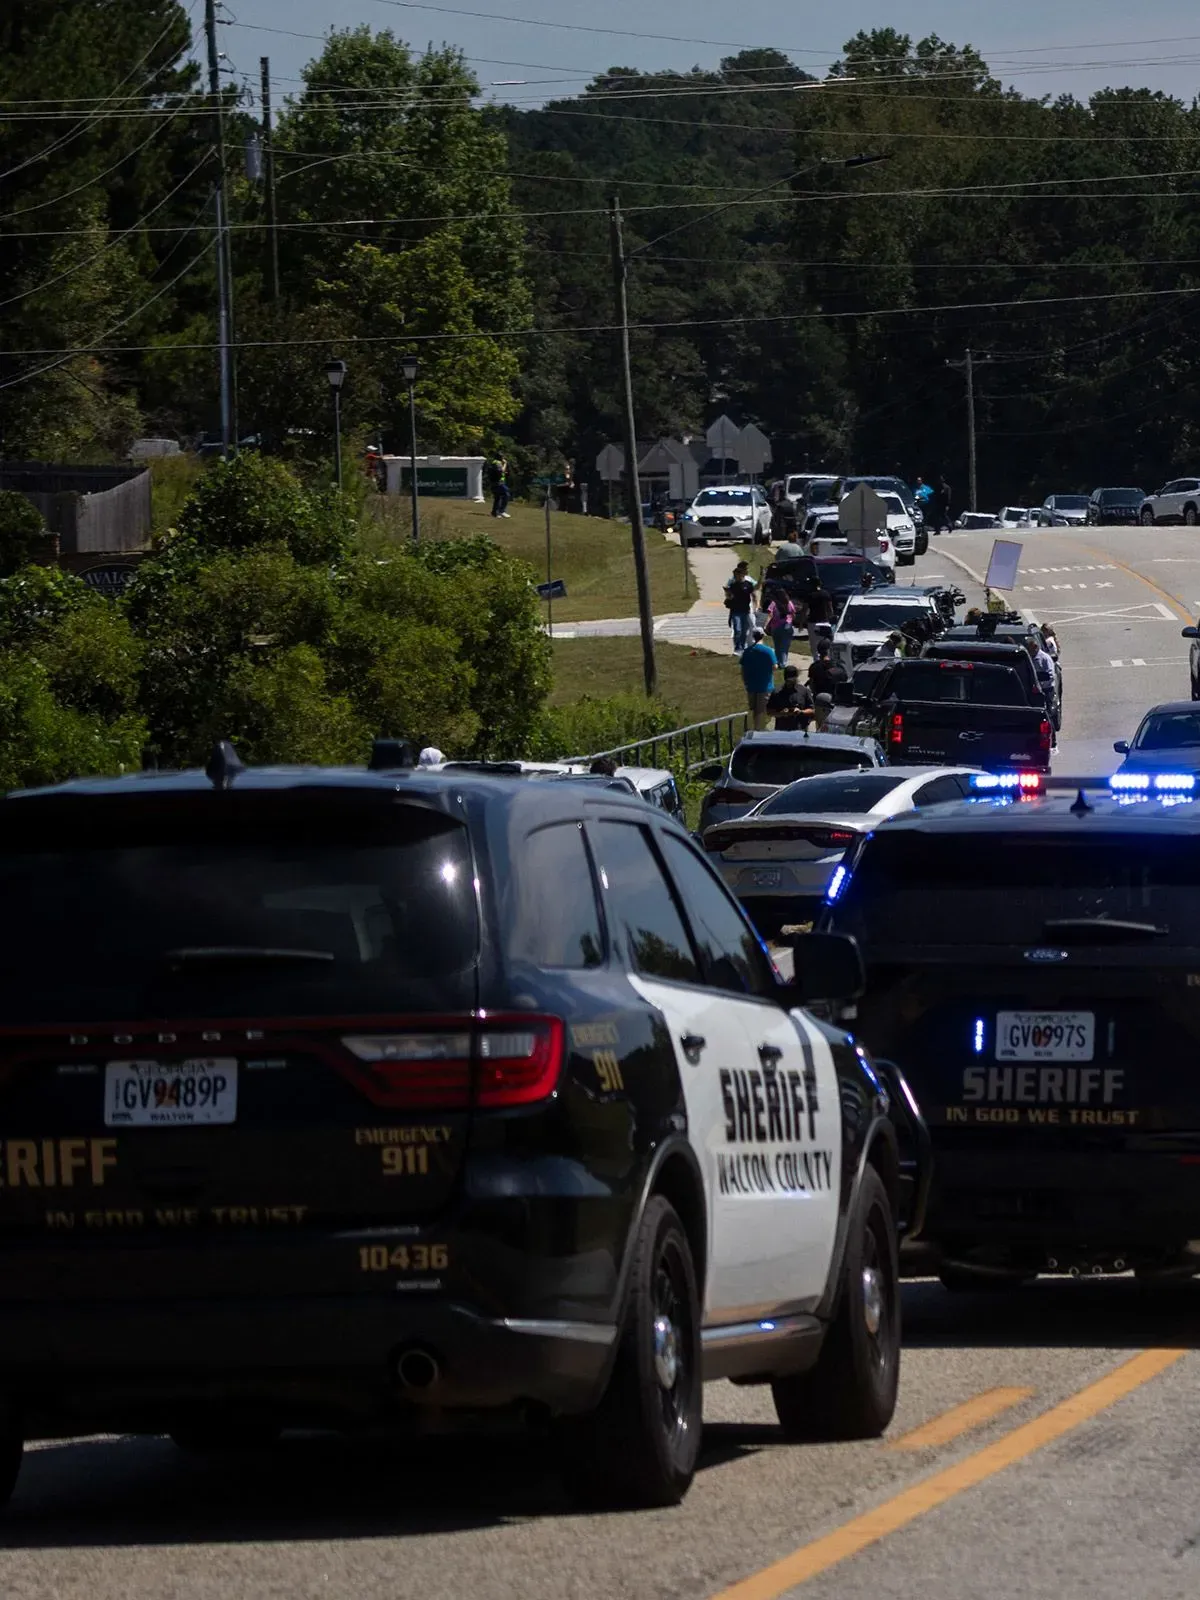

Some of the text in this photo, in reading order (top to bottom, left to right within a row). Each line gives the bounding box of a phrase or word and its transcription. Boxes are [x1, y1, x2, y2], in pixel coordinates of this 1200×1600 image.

[1010, 1025, 1086, 1048] GV0997S
[591, 1049, 625, 1092] 911
[962, 1066, 1125, 1104] SHERIFF
[123, 1076, 227, 1110] GV9489P
[719, 1068, 818, 1142] SHERIFF
[946, 1107, 1140, 1125] IN GOD WE TRUST
[355, 1125, 452, 1145] EMERGENCY
[0, 1137, 119, 1188] RIFF
[380, 1146, 429, 1176] 911
[717, 1149, 832, 1194] WALTON COUNTY
[45, 1204, 309, 1228] IN GOD WE TRUST
[357, 1243, 450, 1272] 10436
